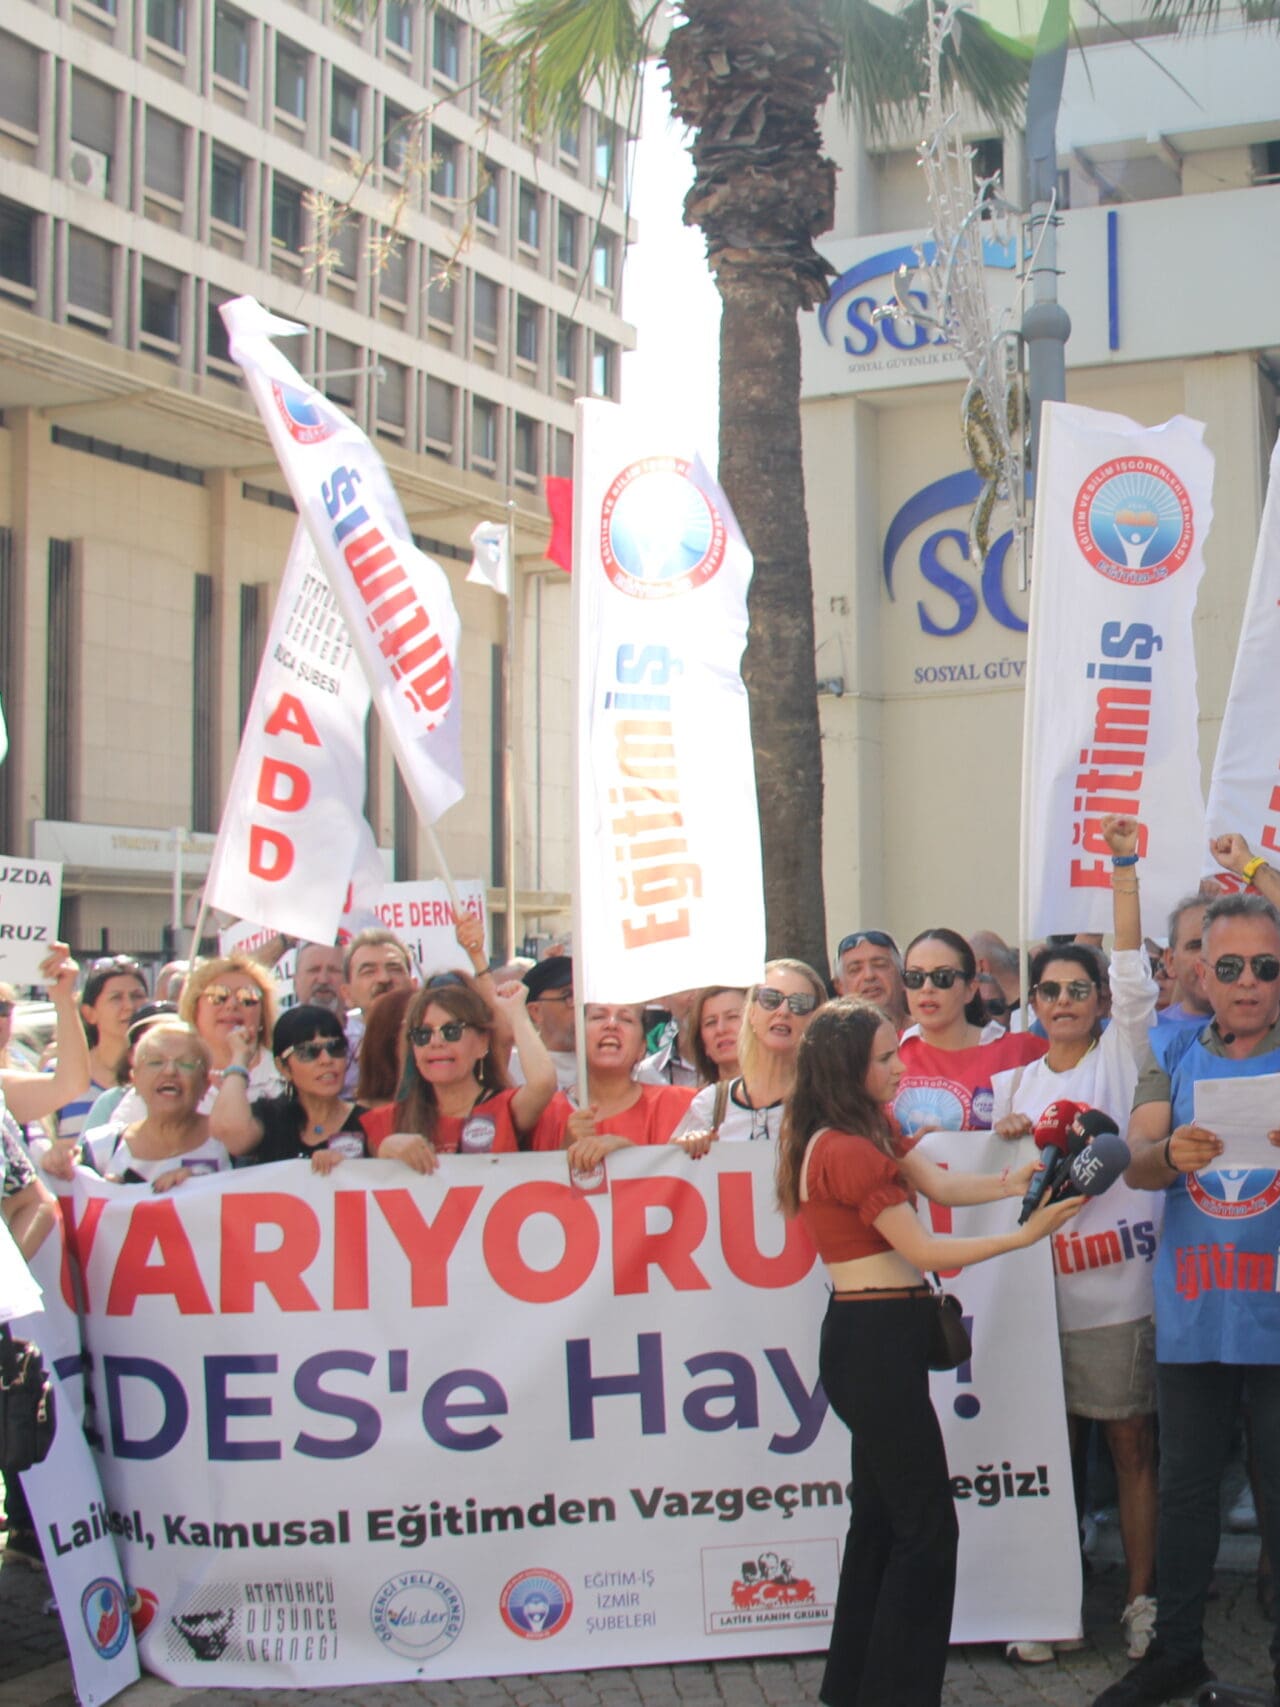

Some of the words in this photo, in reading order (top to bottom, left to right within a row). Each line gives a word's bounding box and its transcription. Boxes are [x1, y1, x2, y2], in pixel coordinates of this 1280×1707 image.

[321, 465, 453, 732] ğitimiş
[296, 659, 341, 696] ŞUBESİ
[914, 664, 980, 684] SOSYAL
[984, 658, 1026, 680] GÜV
[604, 643, 703, 950] Eğitimiş
[0, 867, 52, 886] UZDA
[410, 896, 484, 928] DERNĞİ
[0, 924, 48, 942] RUZ
[1054, 1219, 1157, 1276] timiş
[53, 1348, 508, 1462] DES'e
[163, 1510, 351, 1549] Kamusal
[367, 1492, 616, 1548] Eğitimden
[245, 1577, 335, 1605] ATATÜRKÇÜ
[583, 1569, 656, 1590] EĞİTİM-İŞ
[597, 1592, 640, 1609] İZMİR
[247, 1603, 338, 1633] DÜŞÜNCE
[586, 1614, 657, 1634] ŞUBELERİ
